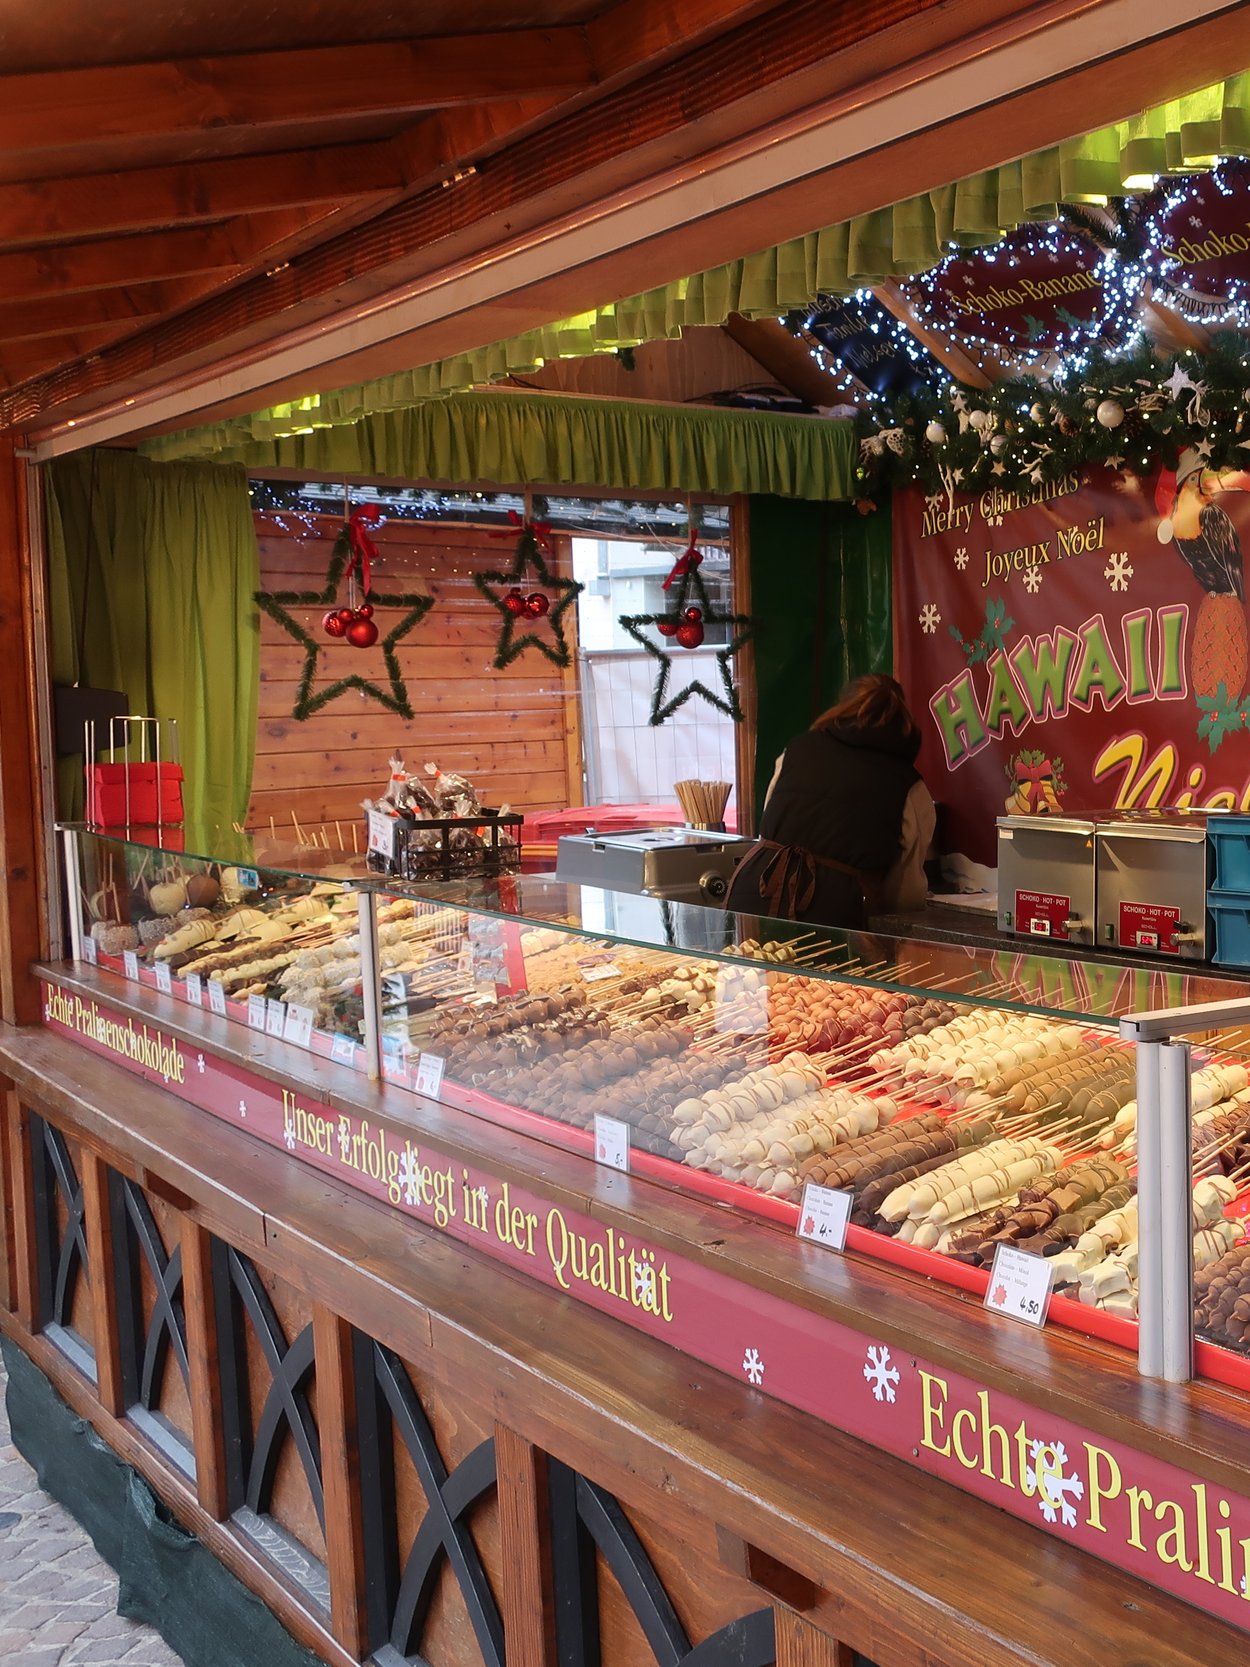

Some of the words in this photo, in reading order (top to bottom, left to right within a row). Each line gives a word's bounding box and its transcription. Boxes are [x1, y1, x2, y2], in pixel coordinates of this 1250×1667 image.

[951, 269, 1103, 316] Schoko-Banane
[920, 503, 974, 539] Merry
[981, 540, 1050, 588] Joyeux
[1056, 516, 1105, 561] Noël
[930, 604, 1189, 771] HAWAII
[1019, 893, 1040, 903] SCHOKO
[1042, 897, 1053, 905] HOT
[1055, 898, 1066, 907] POT
[1123, 905, 1146, 915] SCHOKO
[1149, 908, 1161, 917] HOT
[1164, 910, 1176, 918] POT
[46, 982, 74, 1028] Echte
[75, 995, 185, 1085] Pralinenschokolade
[281, 1088, 335, 1158] Unser
[337, 1114, 401, 1206] Erfolg
[403, 1139, 457, 1228] liegt
[462, 1172, 489, 1234] in
[494, 1181, 539, 1257] der
[545, 1207, 675, 1323] Qualität
[918, 1369, 1066, 1511] Echte
